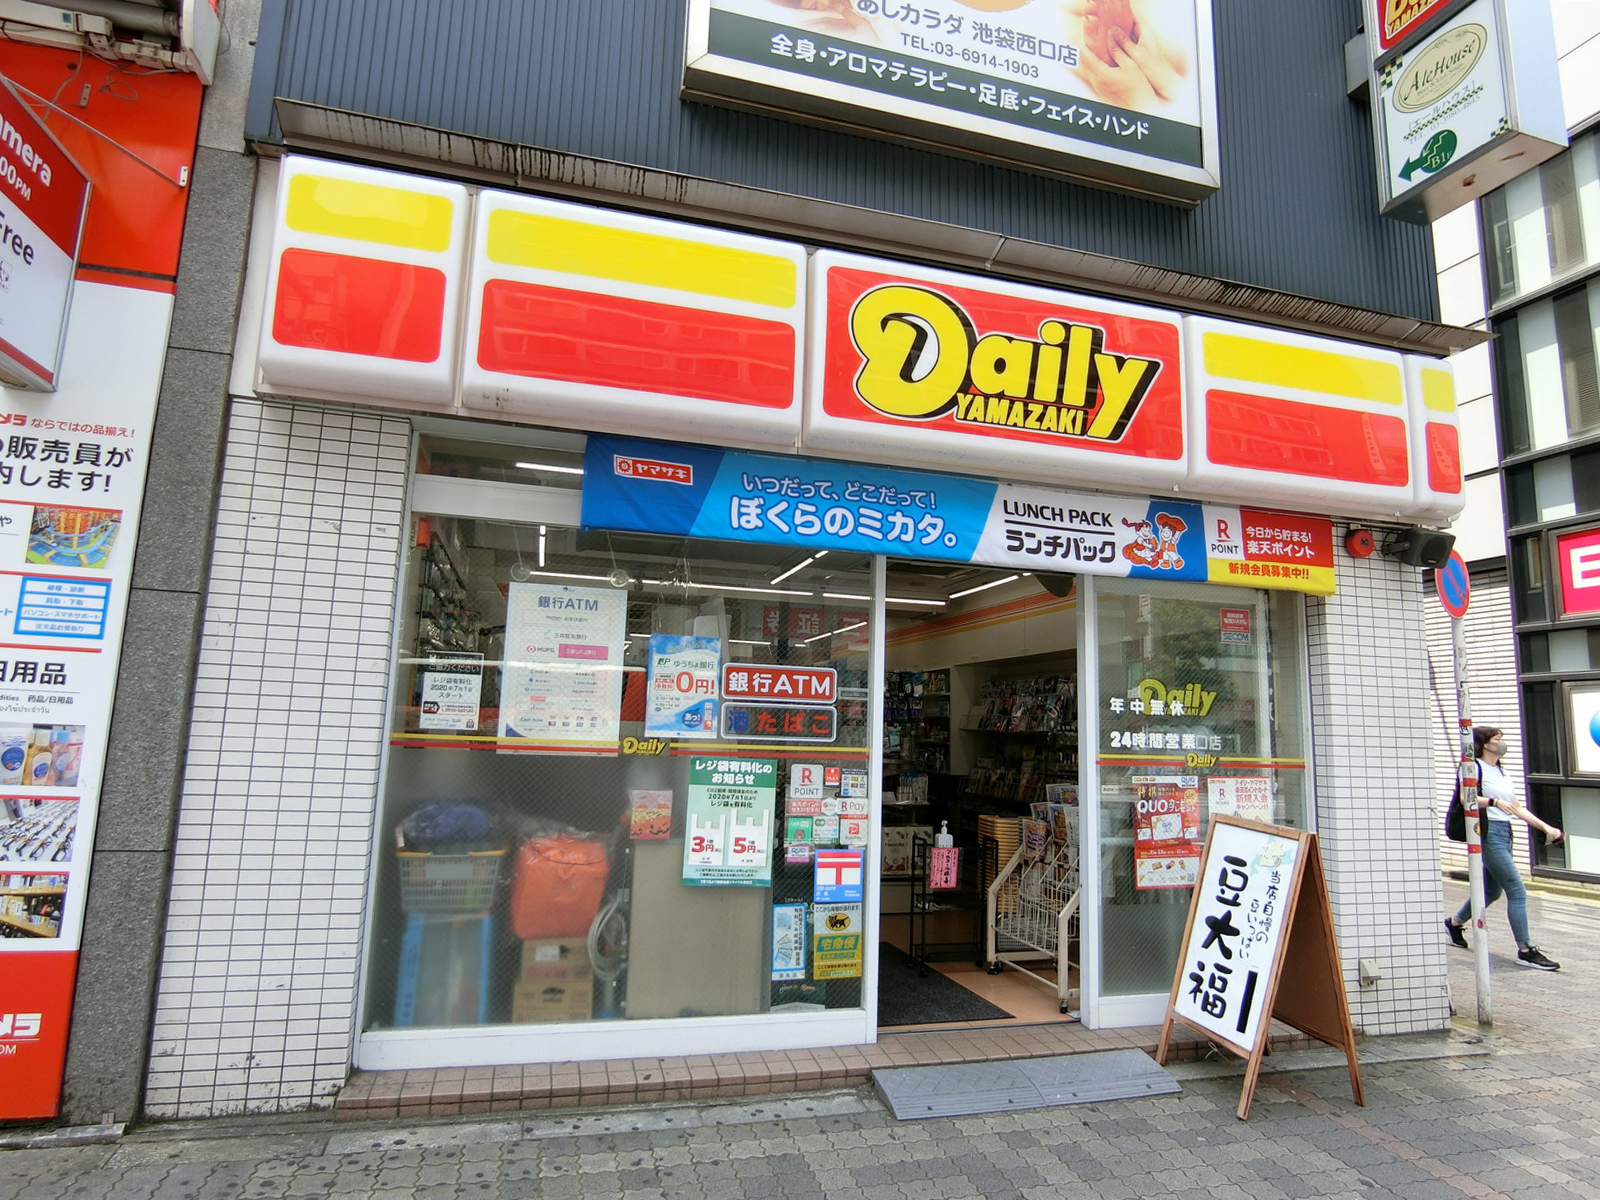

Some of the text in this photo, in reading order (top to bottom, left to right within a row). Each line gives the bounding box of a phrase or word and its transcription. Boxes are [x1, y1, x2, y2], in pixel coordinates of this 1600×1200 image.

[971, 20, 1079, 67] 池袋西口店
[900, 32, 1040, 78] TEL:03-6914-1903
[1404, 39, 1476, 101] AleHouse
[850, 284, 1161, 441] Daily
[955, 391, 1085, 435] YAMAZAKI
[31, 417, 136, 438] ならではの品揃え!
[0, 435, 134, 468] 販売員が
[742, 473, 937, 510] いつだって、どこだって!
[730, 495, 958, 548] ぼくらのミカタ。
[1003, 499, 1114, 529] LUNCH PACK
[1245, 525, 1313, 544] 今日から貯まる!
[1004, 529, 1116, 564] ランチパック
[1211, 543, 1240, 556] POINT
[1245, 540, 1316, 559] 楽天ポイント
[1228, 561, 1310, 581] 新規会員募集中!!
[538, 595, 599, 612] 銀行ATM
[1223, 632, 1249, 641] SECOM
[673, 660, 715, 669] ゆうちょ銀行
[728, 671, 831, 697] 銀行ATM
[1110, 697, 1185, 716] 年中無休
[1139, 678, 1218, 716] Daily
[1164, 706, 1200, 716] YAZAKI
[757, 710, 831, 735] たばこ
[623, 736, 667, 755] Daily
[1110, 731, 1196, 750] 24時間営業
[695, 760, 773, 774] レジ袋有料化の
[1187, 752, 1218, 768] Daily
[711, 773, 756, 784] お知らせ
[794, 787, 820, 796] POINT
[849, 801, 865, 811] Pay
[1137, 799, 1169, 814] QUO
[1256, 871, 1281, 944] 当店自慢の
[1188, 855, 1249, 1020] 豆大福
